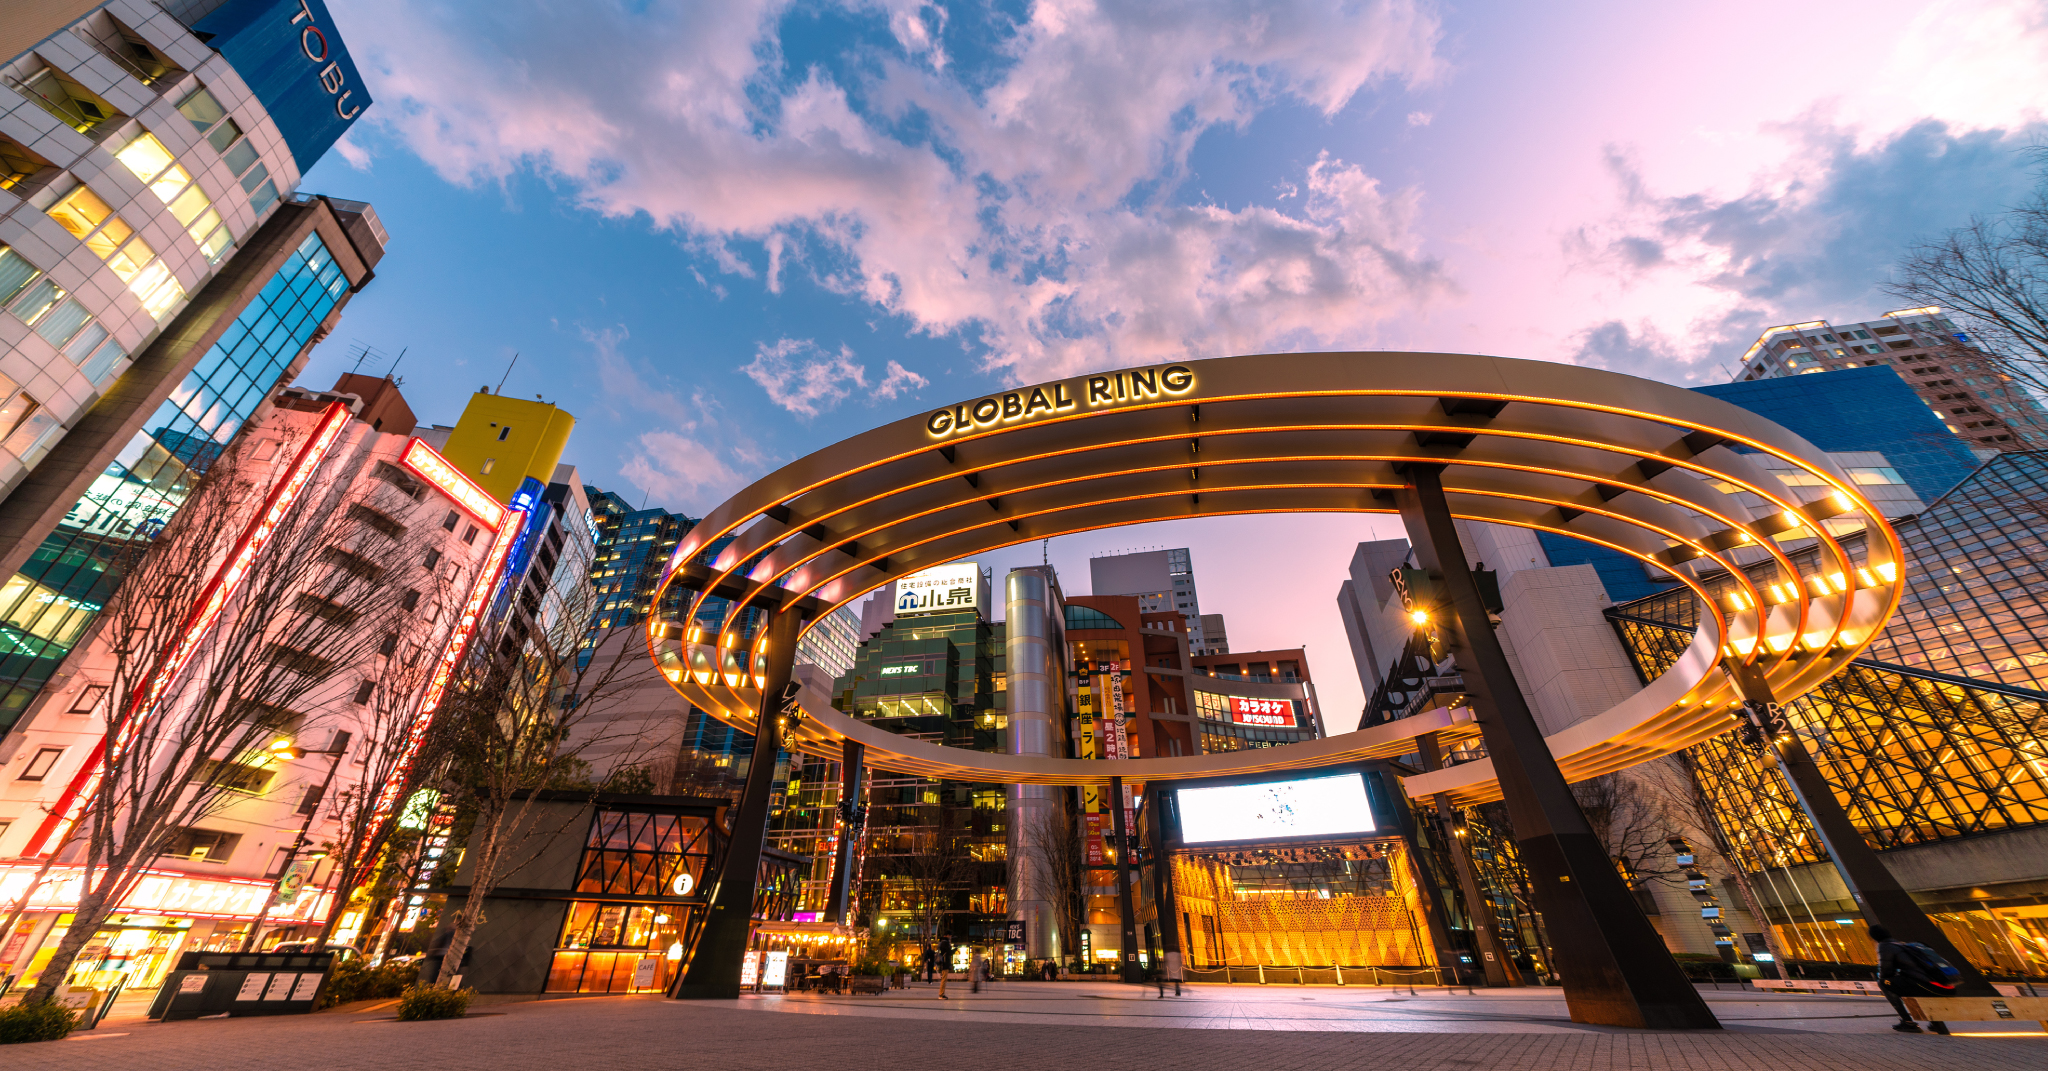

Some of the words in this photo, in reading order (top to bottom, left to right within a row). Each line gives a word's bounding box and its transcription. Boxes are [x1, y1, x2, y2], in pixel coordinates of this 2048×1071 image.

[291, 0, 360, 120] TOBU
[927, 384, 1073, 436] GLOBAL
[1088, 365, 1192, 404] RING
[412, 450, 456, 487] カラオケ
[900, 577, 973, 590] 住宅設備の総合商社
[919, 587, 973, 608] 小泉
[903, 665, 918, 673] TBC
[1110, 663, 1119, 671] 2F
[1239, 700, 1283, 714] カラオケ
[1243, 713, 1284, 725] JOYSOUND
[165, 880, 254, 913] カラオケ
[1008, 929, 1022, 939] TBC
[638, 963, 654, 971] CAFÉ
